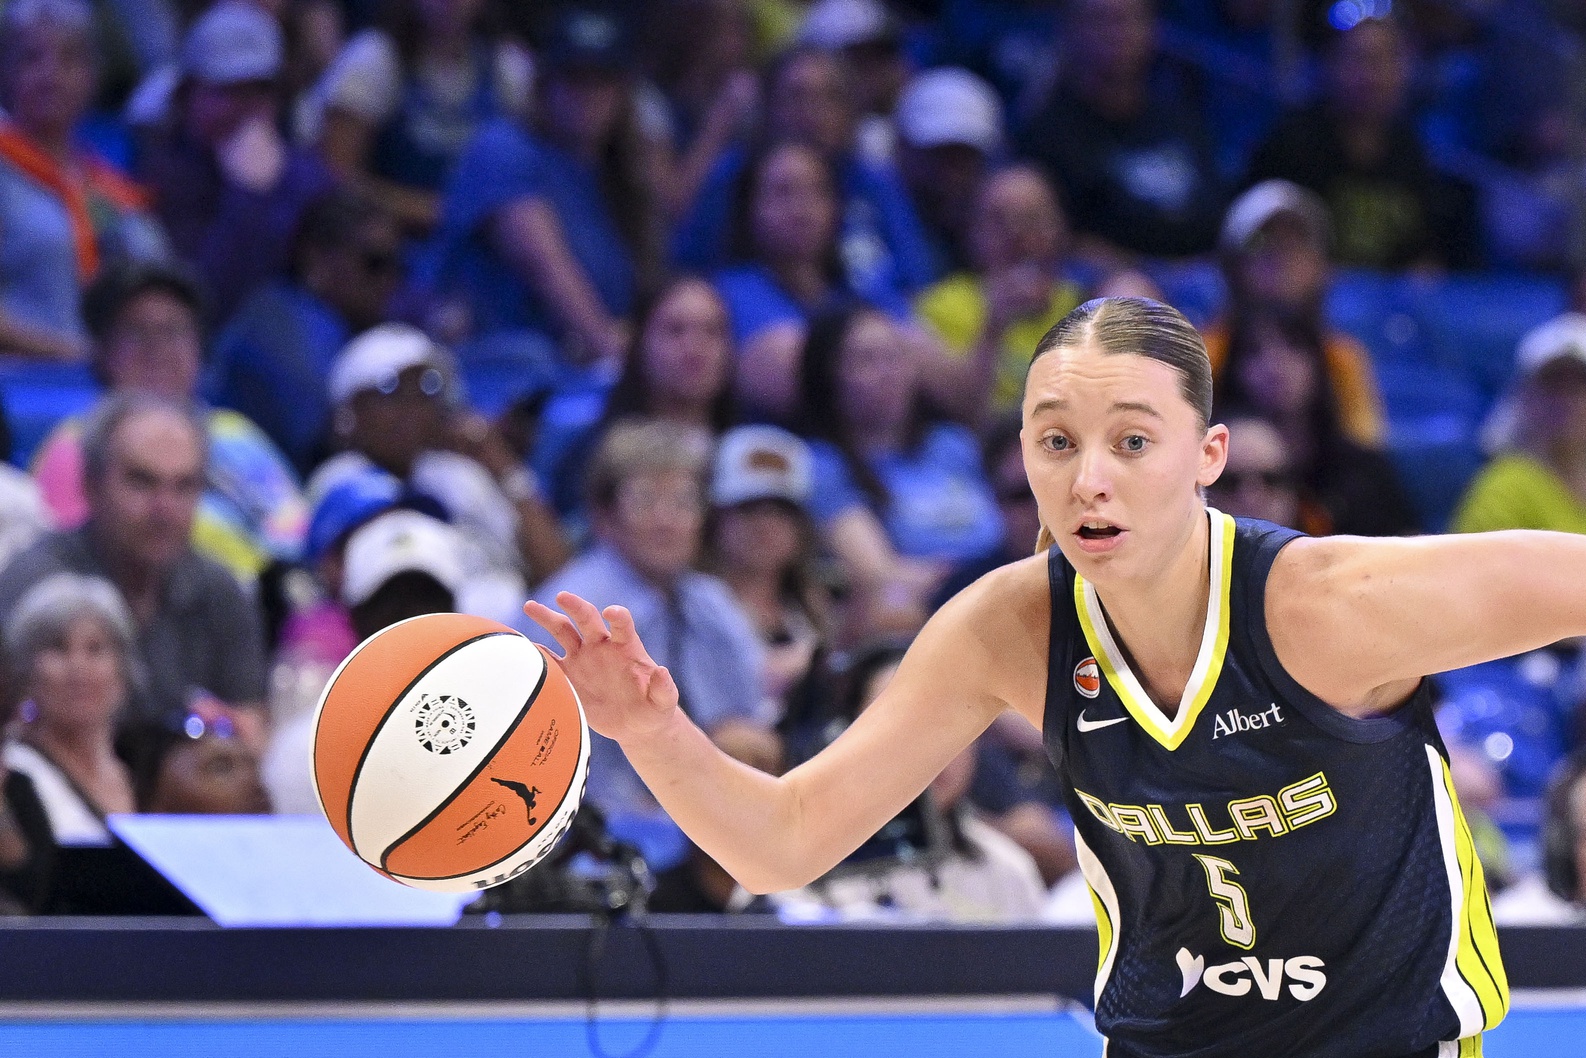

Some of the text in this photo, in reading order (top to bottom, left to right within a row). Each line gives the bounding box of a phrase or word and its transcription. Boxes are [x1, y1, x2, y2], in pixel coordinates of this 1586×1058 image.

[1212, 702, 1285, 740] Albert
[1074, 771, 1338, 846] DALLAS
[1191, 853, 1257, 950] 5
[1202, 955, 1327, 1001] CVS
